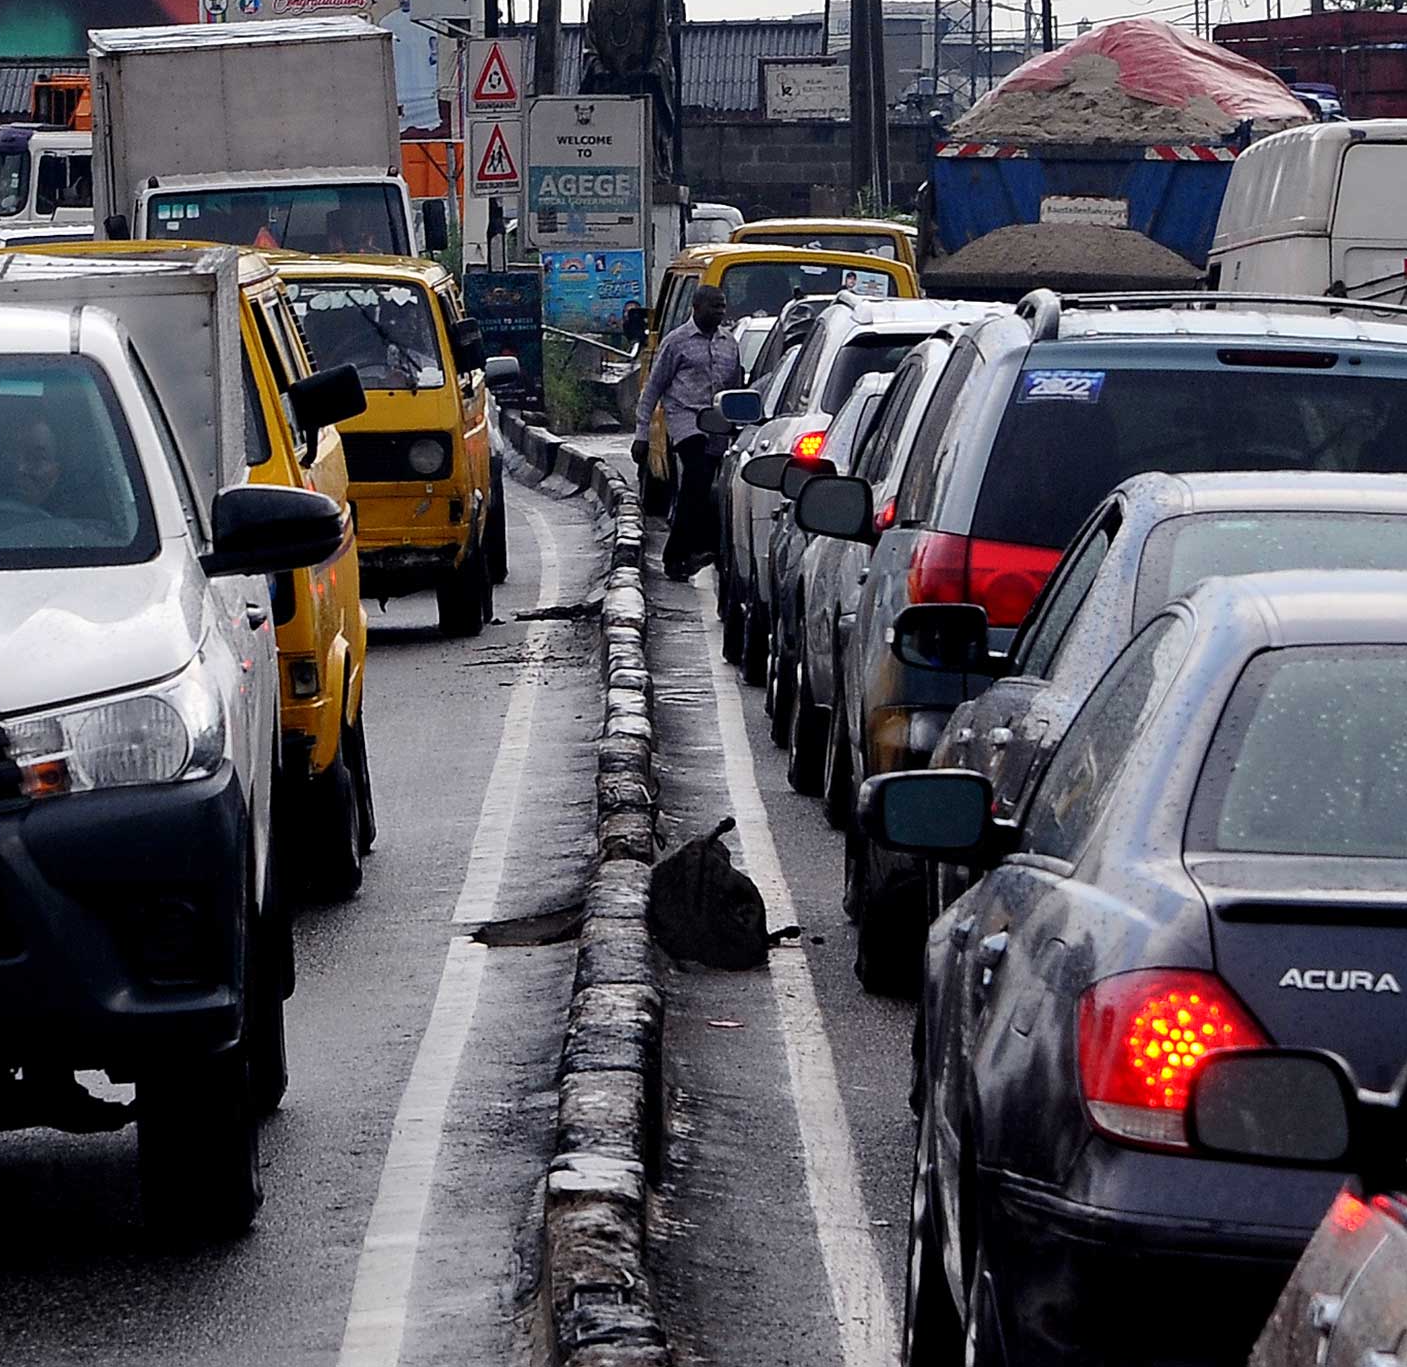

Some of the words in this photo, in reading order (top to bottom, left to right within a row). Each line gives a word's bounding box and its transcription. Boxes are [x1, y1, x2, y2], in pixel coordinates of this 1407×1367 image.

[556, 136, 612, 145] WELCOME
[577, 149, 592, 158] TO
[539, 174, 630, 196] AGEGE
[1279, 968, 1400, 993] ACURA
